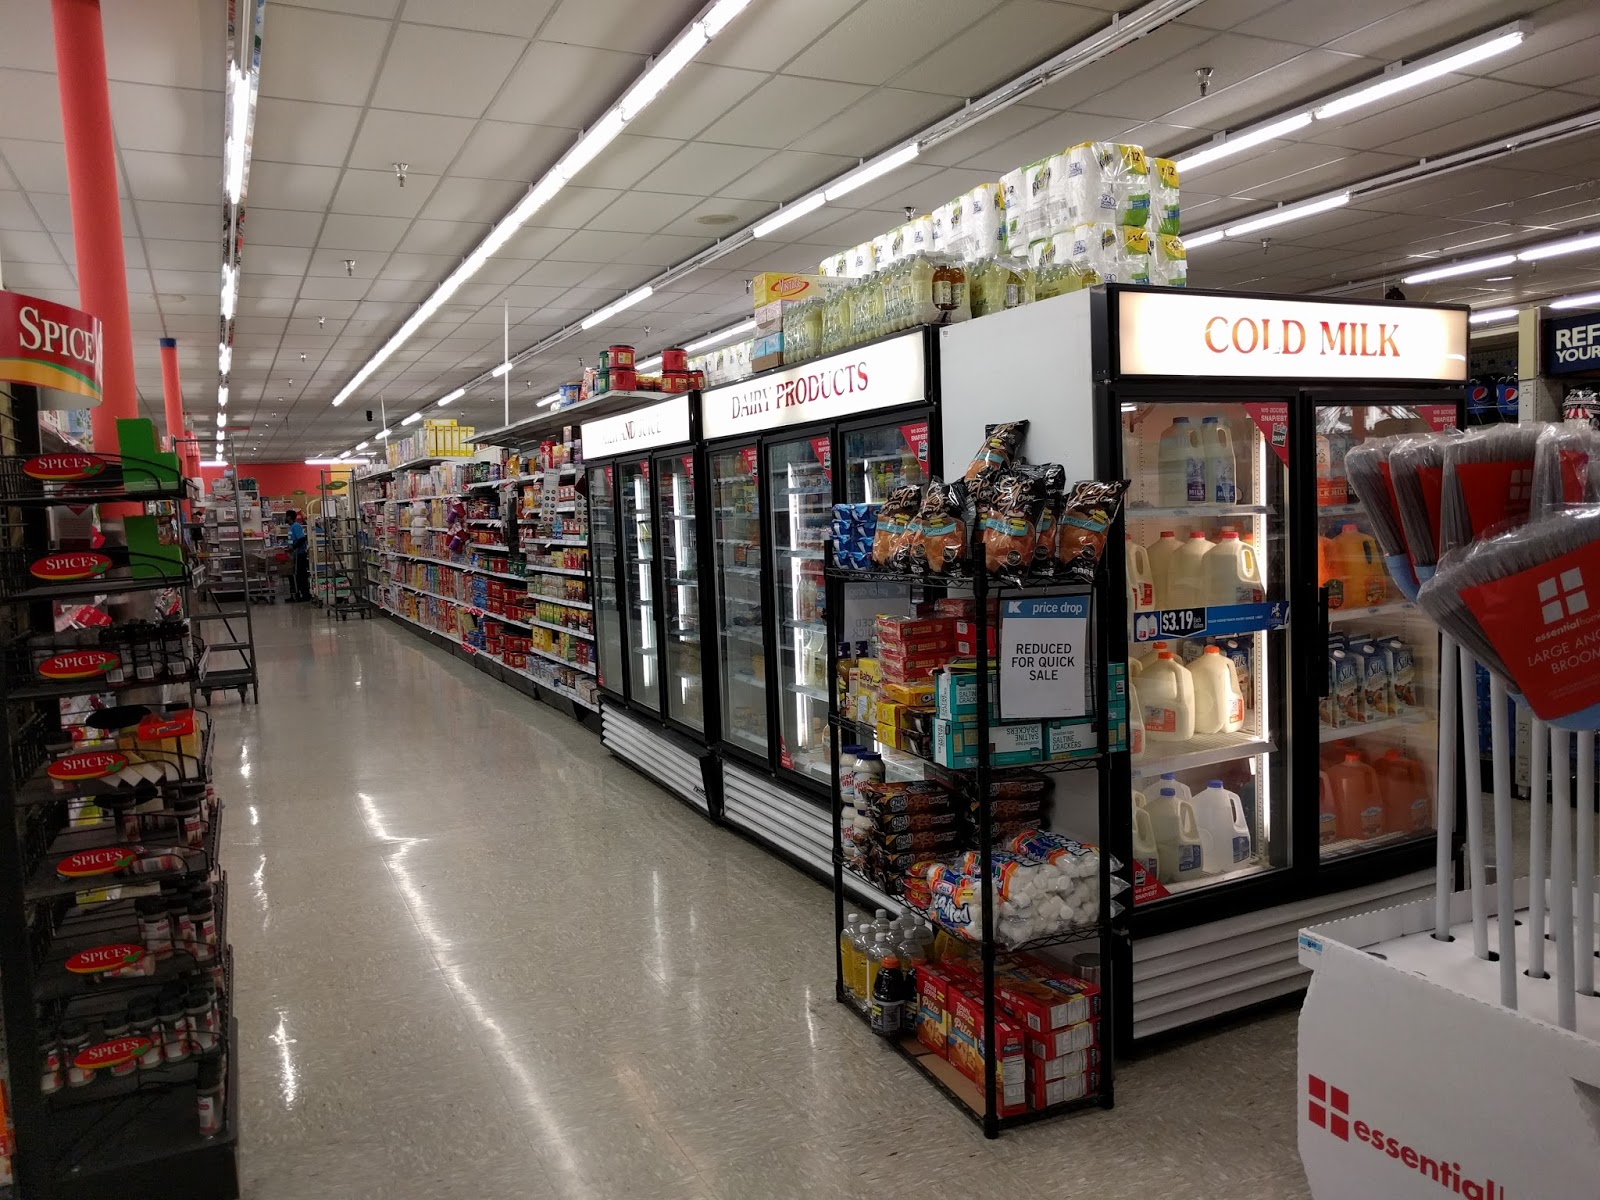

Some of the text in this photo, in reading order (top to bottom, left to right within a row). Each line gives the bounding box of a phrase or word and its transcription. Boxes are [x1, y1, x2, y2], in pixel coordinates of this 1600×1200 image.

[19, 306, 97, 364] SPICE
[1204, 315, 1401, 358] COLD MILK
[1555, 345, 1600, 364] YOUR
[775, 361, 869, 410] PRODUCTS
[1260, 414, 1288, 422] SNAP/EBT
[38, 456, 92, 470] SPICES
[45, 556, 99, 571] SPICES
[1032, 601, 1058, 616] price
[1060, 601, 1083, 616] drop
[1161, 610, 1194, 632] $3.19
[1016, 643, 1072, 655] REDUCED
[1527, 641, 1571, 668] LARGE
[54, 653, 107, 669] SPICES
[1011, 656, 1075, 669] FOR QUICK
[1029, 670, 1059, 681] SALE
[1338, 665, 1355, 683] Silk
[1367, 661, 1384, 678] Silk
[958, 690, 977, 698] SALTIN
[1006, 725, 1039, 736] CRACKERS
[1014, 732, 1039, 743] SALTINE
[1052, 735, 1075, 744] SALTINE
[1052, 741, 1082, 751] CRACKERS
[63, 755, 115, 771] SPICES
[71, 850, 124, 867] SPICES
[80, 946, 132, 964] SPICES
[921, 995, 941, 1015] Pita
[954, 1017, 973, 1038] Pita
[88, 1039, 140, 1060] SPICES
